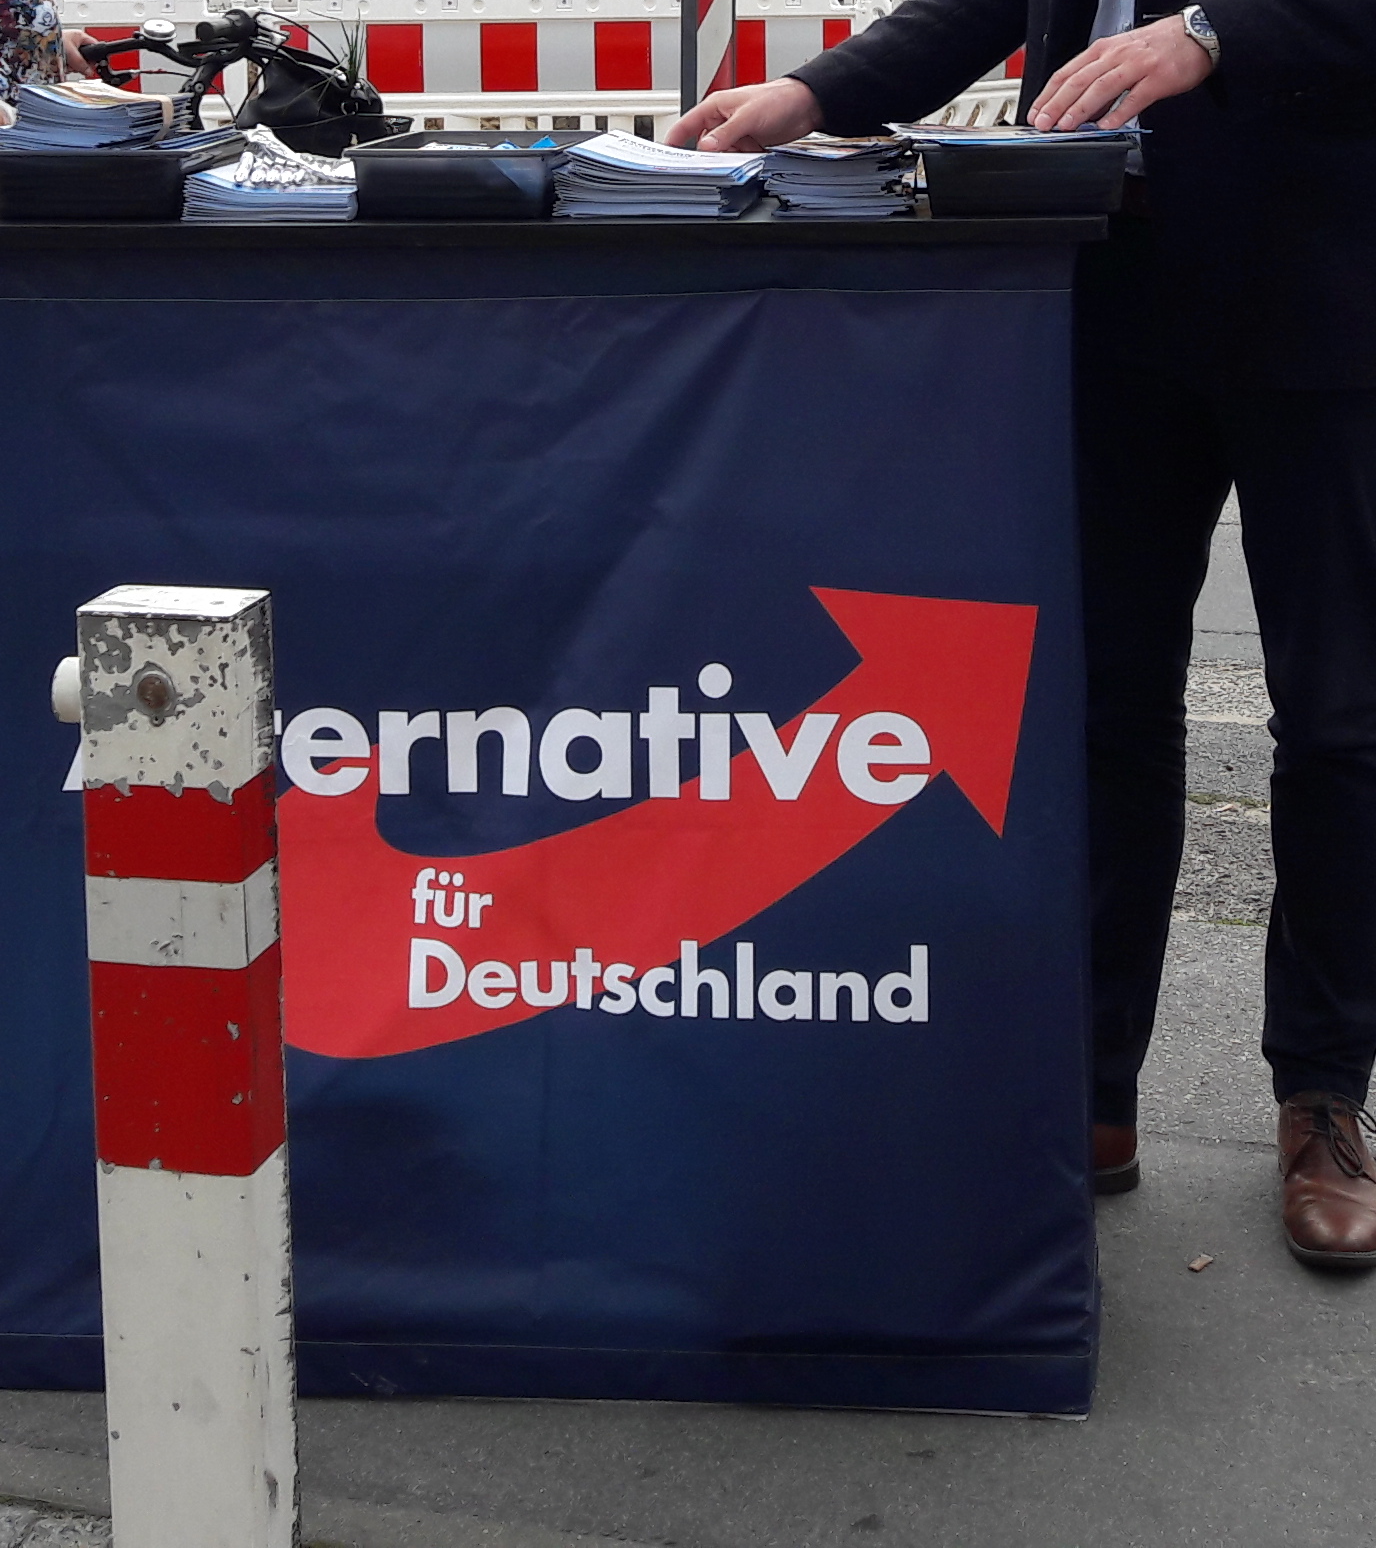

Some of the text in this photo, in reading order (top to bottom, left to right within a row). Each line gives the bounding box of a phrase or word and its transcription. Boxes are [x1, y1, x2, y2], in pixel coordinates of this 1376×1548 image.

[62, 663, 932, 807] ernative
[411, 867, 493, 929] für
[408, 940, 930, 1024] Deutschland
